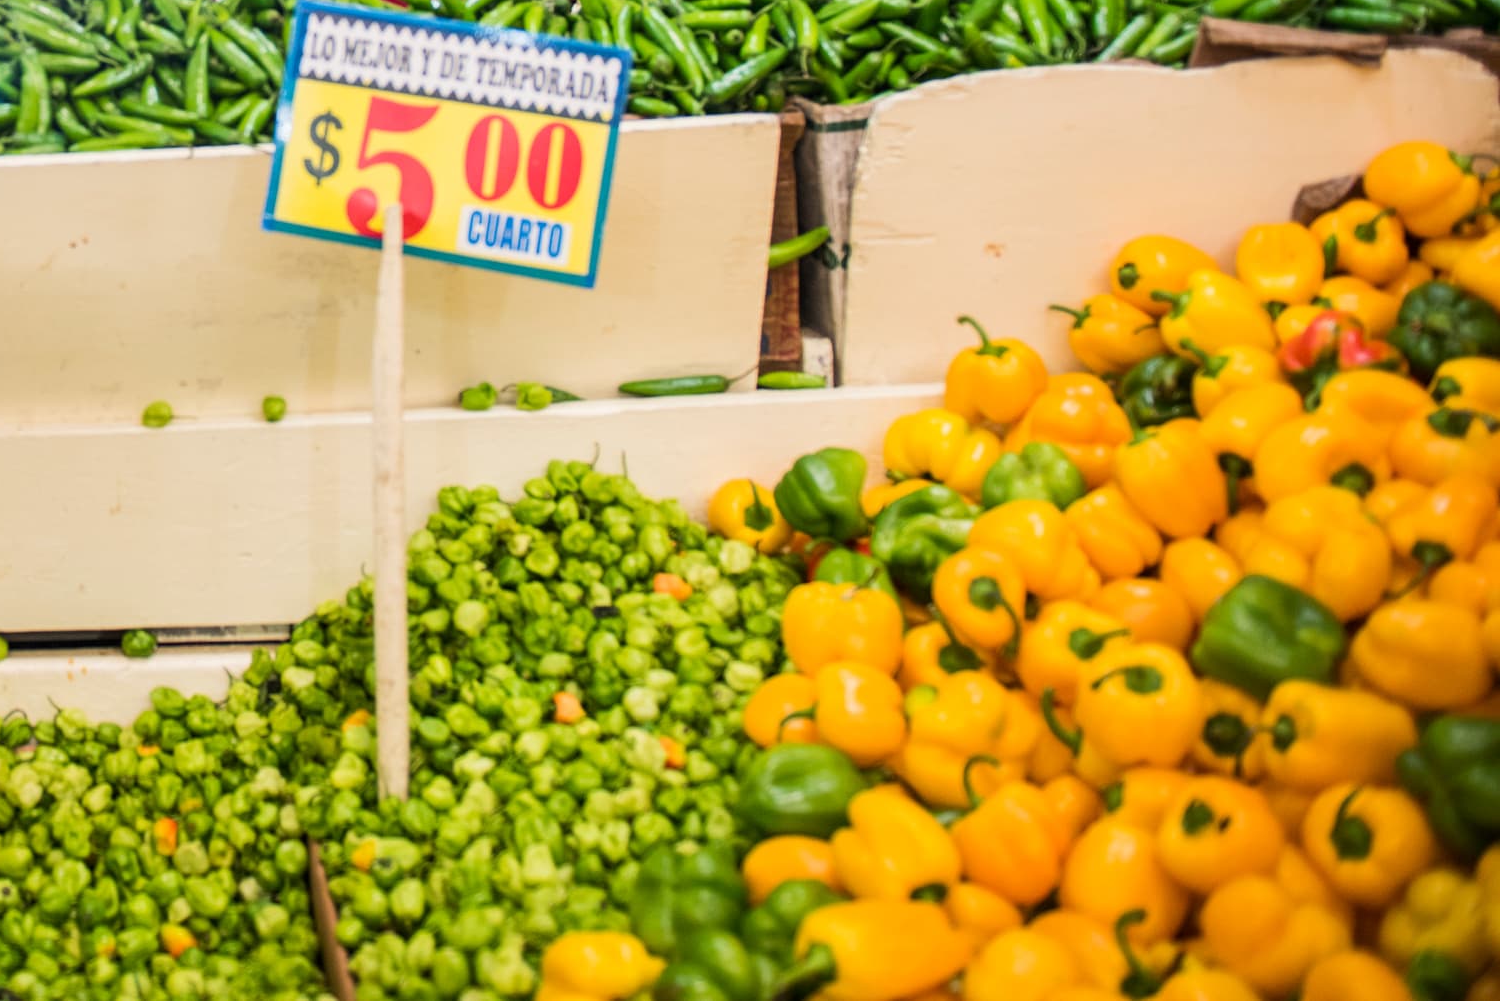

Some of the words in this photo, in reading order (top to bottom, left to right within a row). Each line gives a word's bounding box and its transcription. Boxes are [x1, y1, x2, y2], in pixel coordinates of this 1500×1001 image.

[311, 33, 336, 62] LO
[344, 37, 412, 75] MEJOR
[420, 47, 433, 73] Y
[440, 50, 467, 81] DE
[476, 57, 608, 104] TEMPORADA
[467, 210, 564, 258] CUARTO
